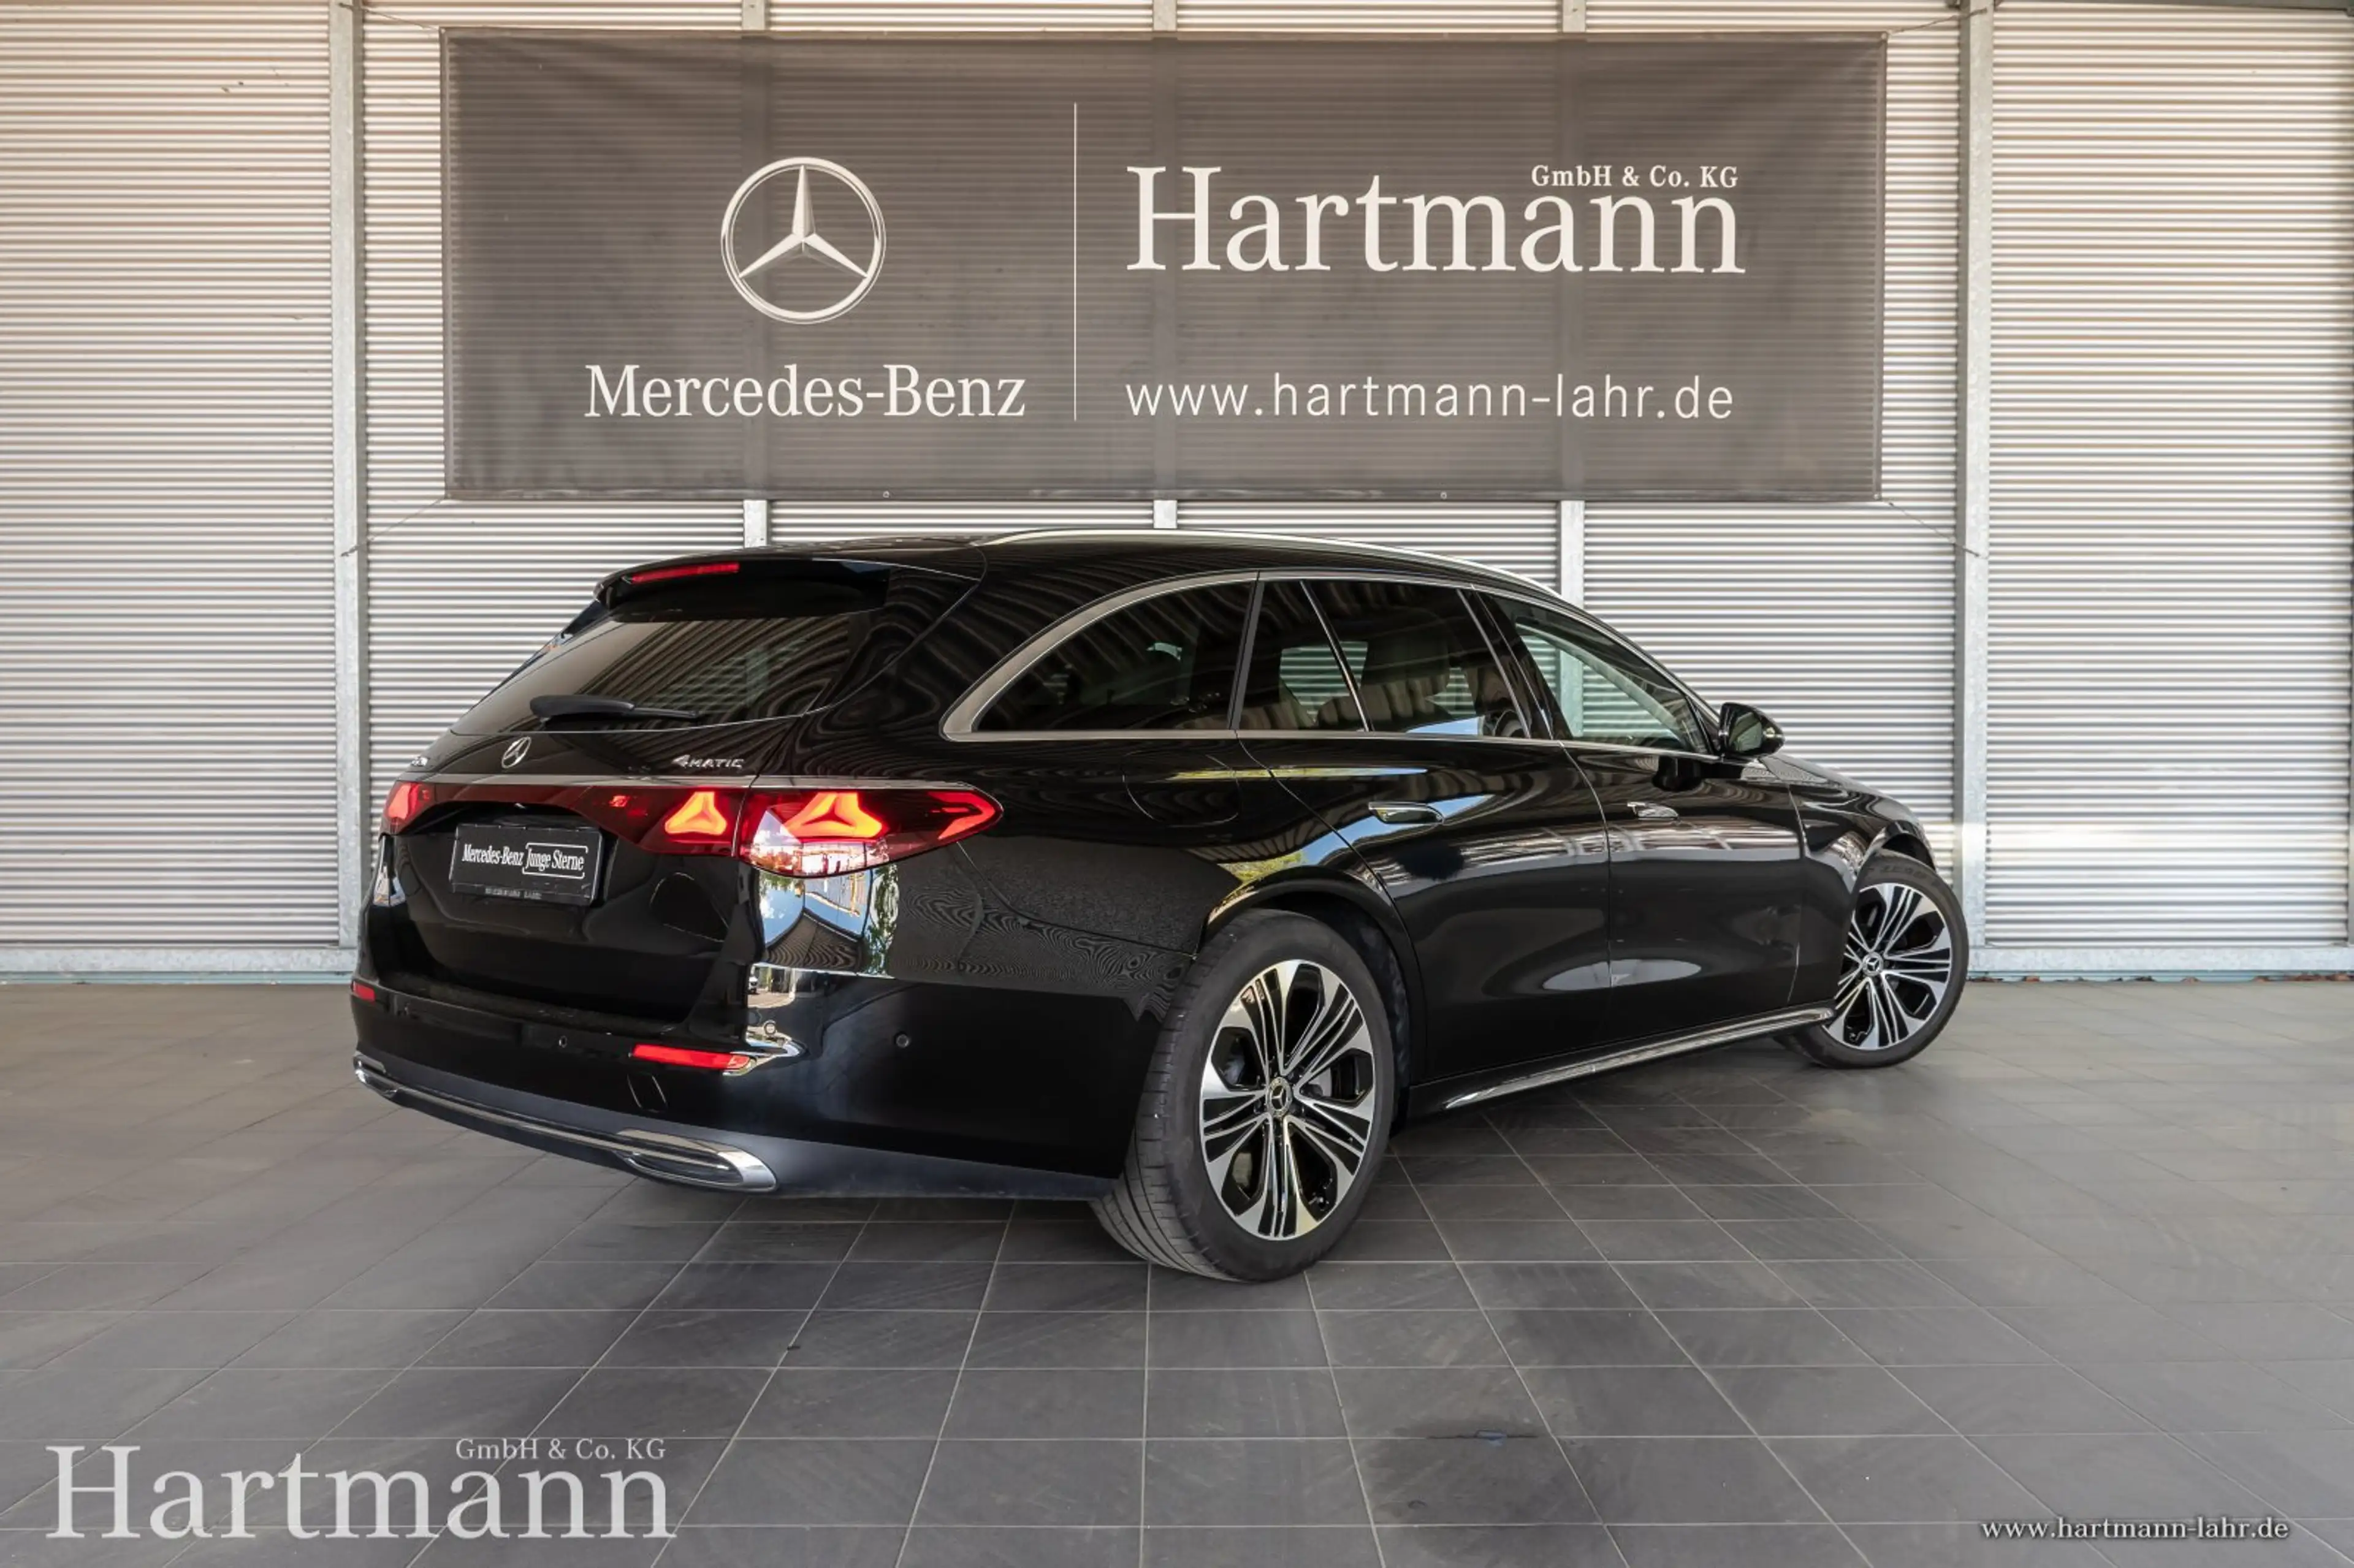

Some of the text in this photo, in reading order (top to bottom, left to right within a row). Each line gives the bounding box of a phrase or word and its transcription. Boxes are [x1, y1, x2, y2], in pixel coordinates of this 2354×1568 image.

[1531, 164, 1738, 188] GmbH & Co. KG
[1126, 166, 1746, 274] Hartmann
[584, 363, 1026, 418] Mercedes-Benz
[1125, 371, 1734, 420] www.hartmann-lahr.de
[672, 754, 744, 769] 4MATIC
[462, 844, 585, 871] Mercedes-Benz Junge Sterne
